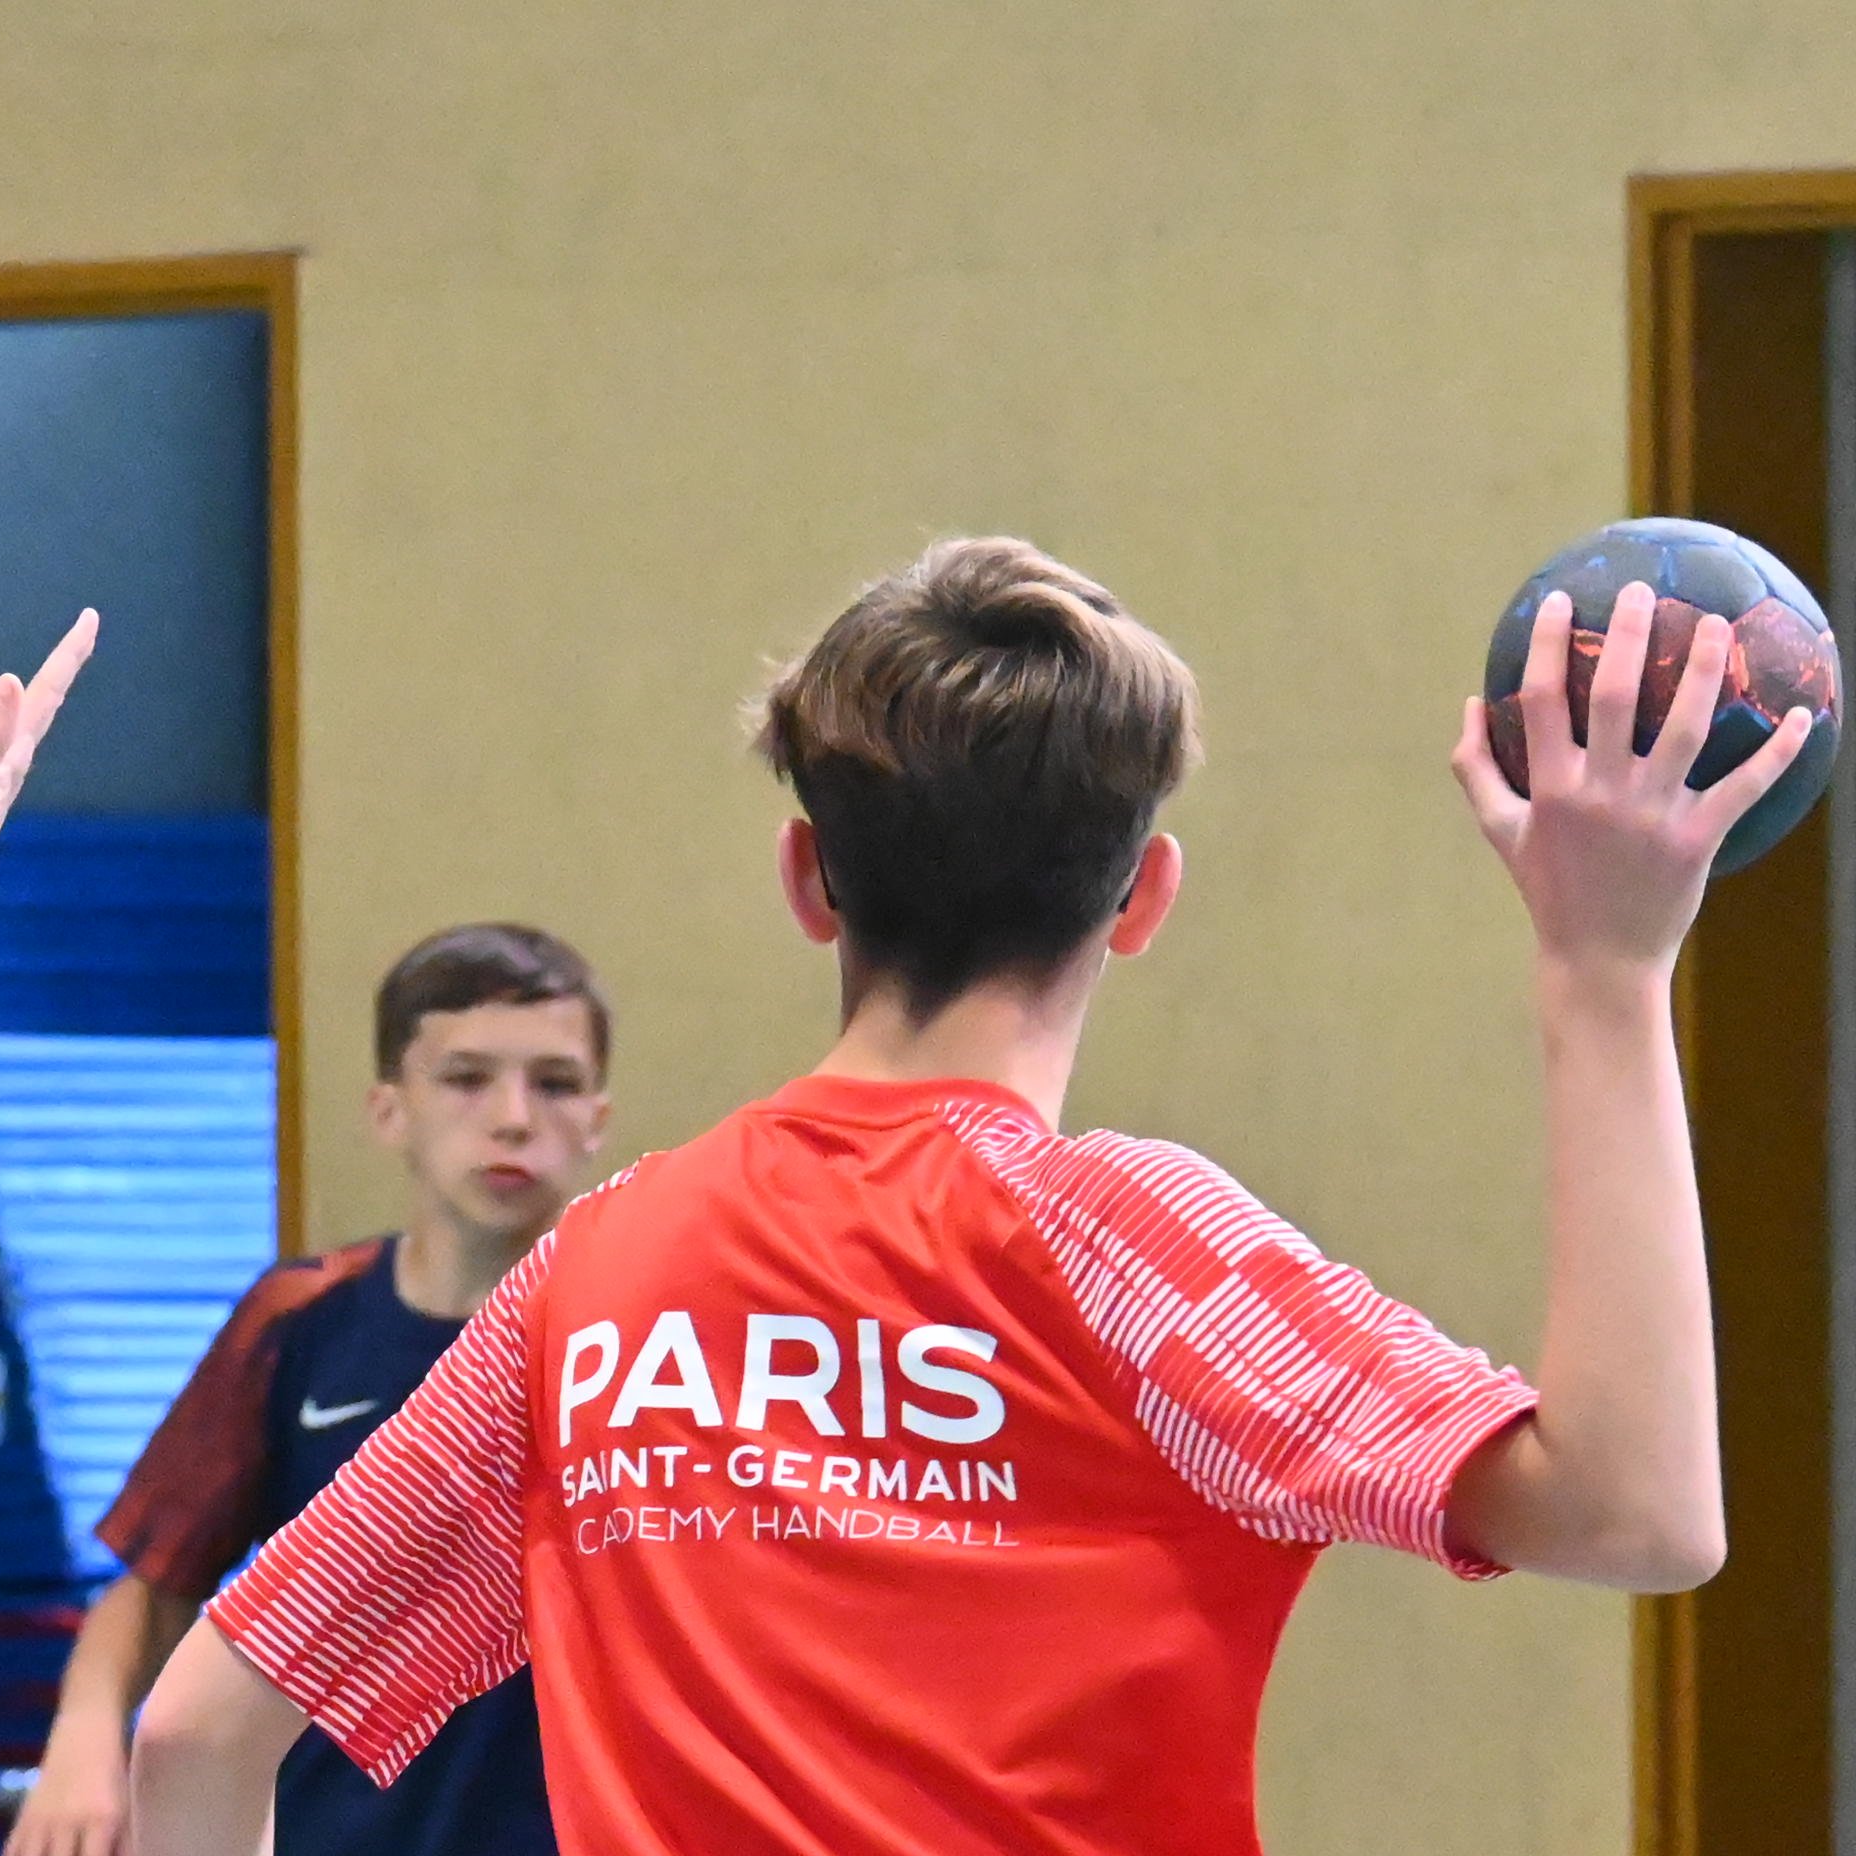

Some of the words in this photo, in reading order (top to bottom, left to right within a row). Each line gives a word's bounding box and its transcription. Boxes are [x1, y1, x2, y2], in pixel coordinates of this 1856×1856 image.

[559, 1311, 1006, 1446] PARIS
[562, 1445, 1017, 1508] SAINT-GERMAIN
[573, 1506, 736, 1555] CADEMY
[752, 1505, 1020, 1548] HANDBALL
